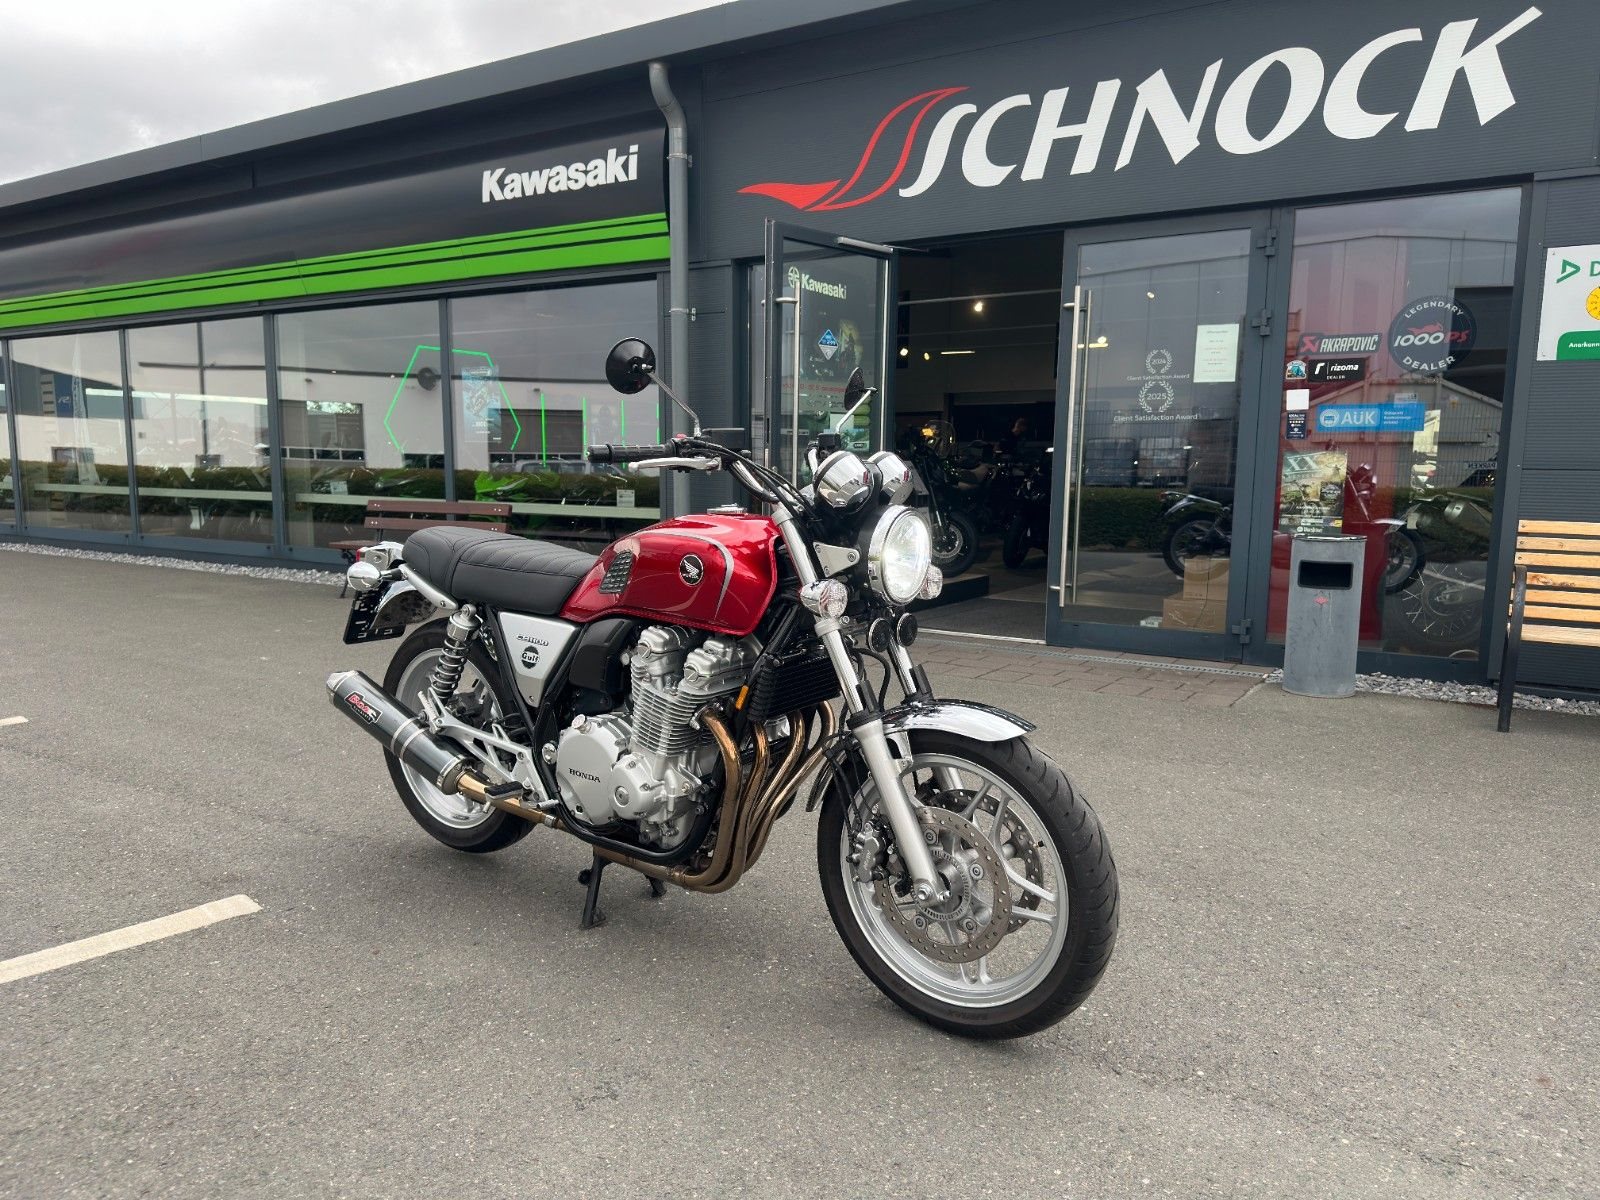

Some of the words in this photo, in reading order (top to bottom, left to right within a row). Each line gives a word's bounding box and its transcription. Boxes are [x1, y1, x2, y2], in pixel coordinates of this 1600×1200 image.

[899, 6, 1543, 198] SCHNOCK
[482, 144, 638, 203] Kawasaki
[801, 273, 847, 300] Kawasaki
[1404, 301, 1464, 319] LEGENDARY
[1393, 329, 1472, 347] 1000PS
[1330, 363, 1359, 372] rizoma
[1402, 356, 1456, 371] DEALER
[1146, 392, 1167, 400] 2025
[1134, 413, 1175, 421] Satisfaction
[1175, 413, 1198, 421] Award
[521, 651, 540, 663] Gulf
[568, 767, 601, 783] HONDA
